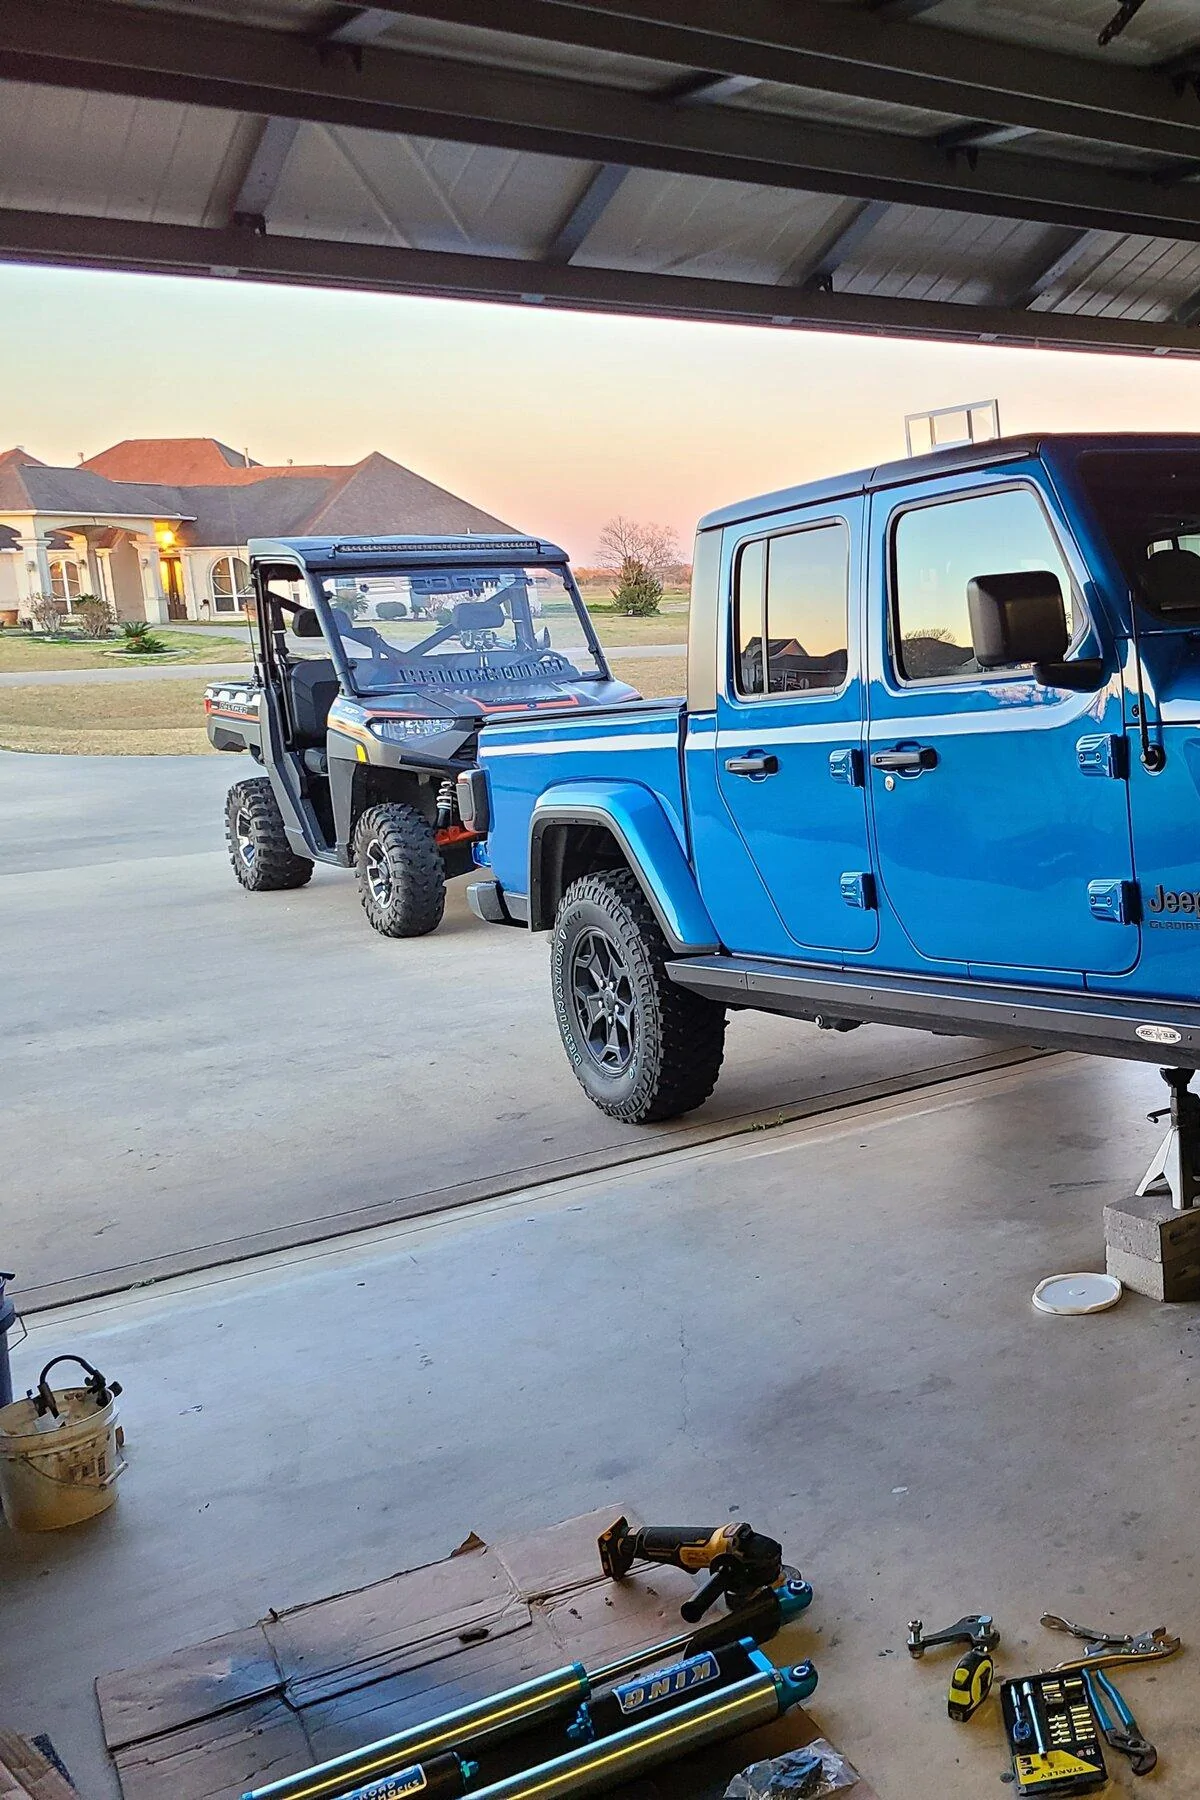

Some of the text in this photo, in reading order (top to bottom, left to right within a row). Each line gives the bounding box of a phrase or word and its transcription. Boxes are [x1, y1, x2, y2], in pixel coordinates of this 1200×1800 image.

[556, 942, 582, 1067] DESTINATION
[624, 1661, 711, 1709] KING
[1040, 1766, 1084, 1779] STANLEY
